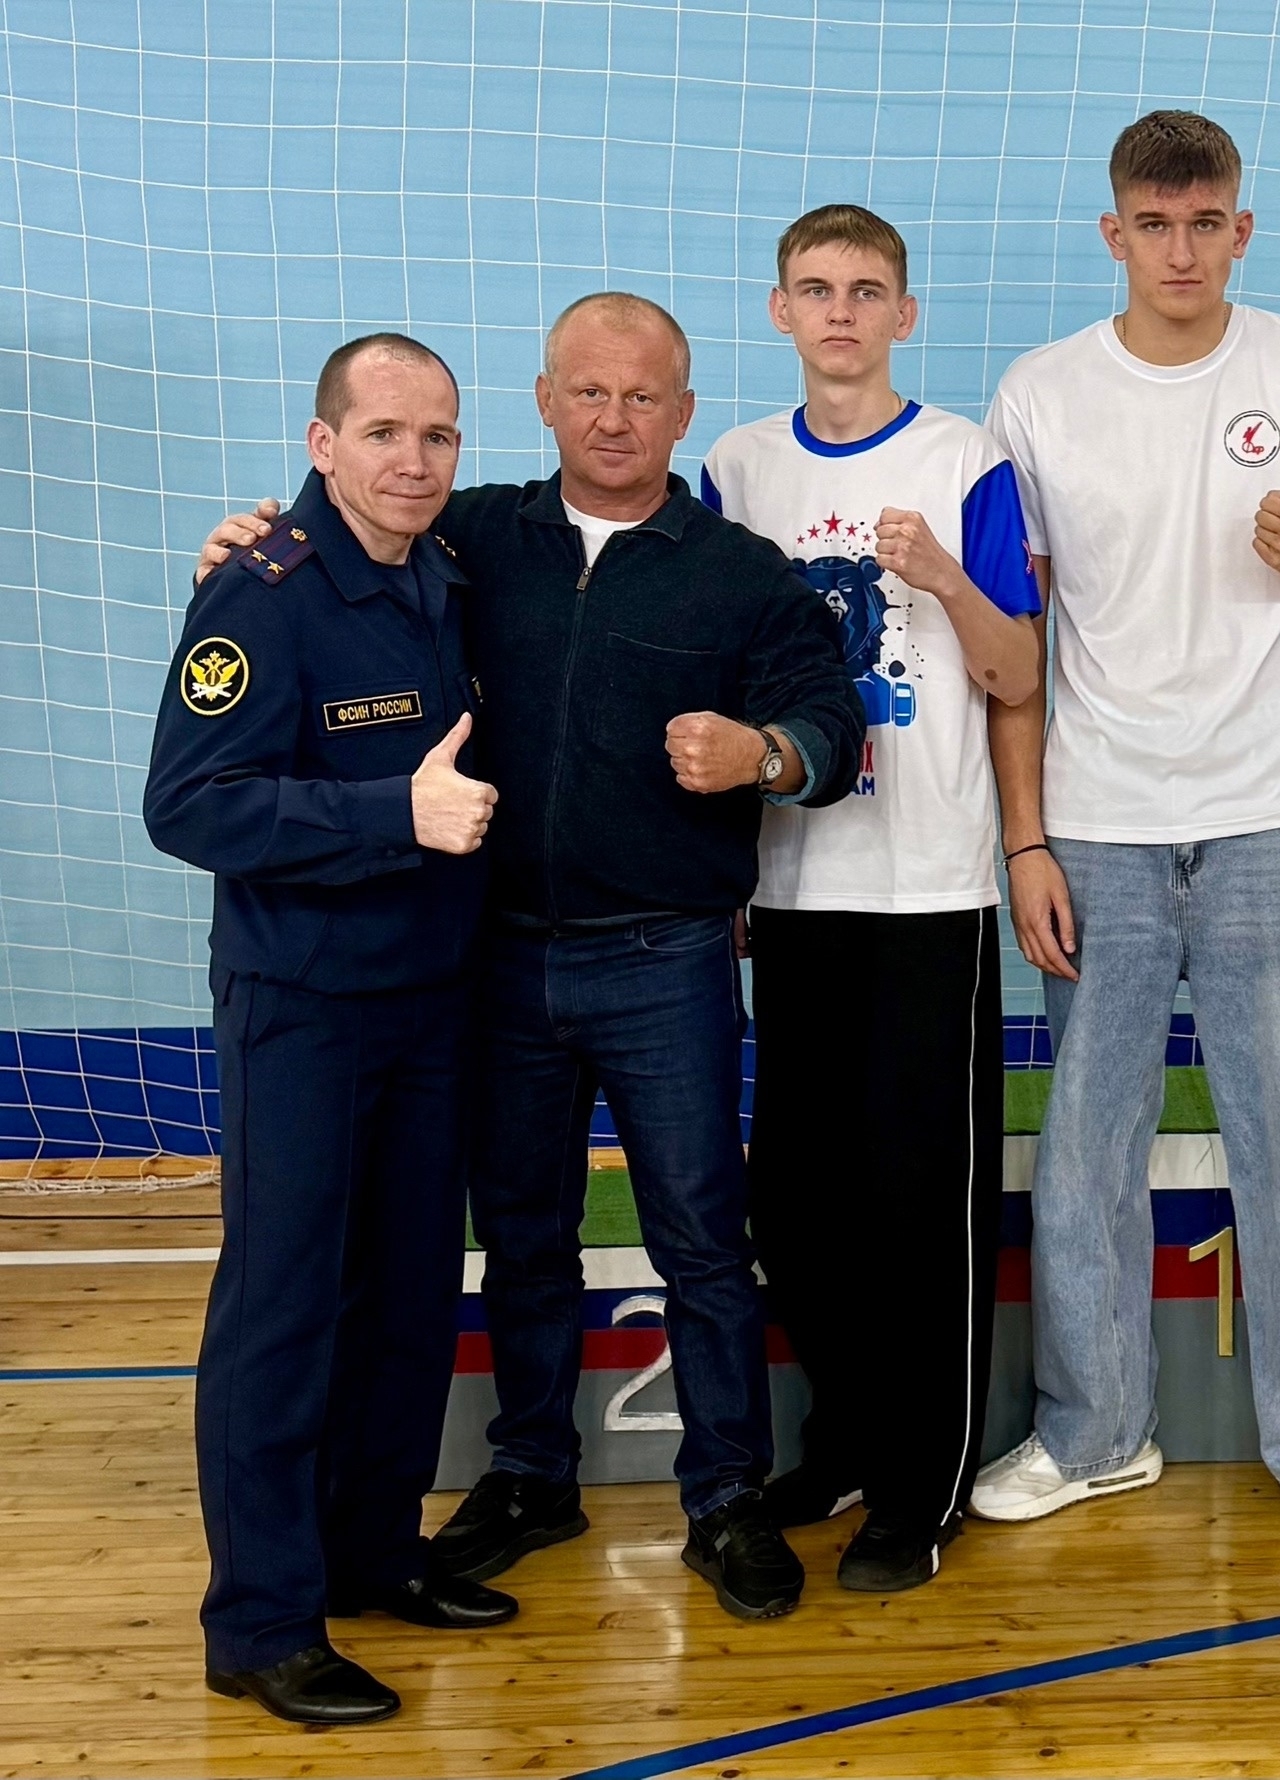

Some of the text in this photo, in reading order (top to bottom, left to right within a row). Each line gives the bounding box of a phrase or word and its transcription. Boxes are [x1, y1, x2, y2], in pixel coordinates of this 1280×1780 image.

[337, 698, 413, 722] ФСИН РОССИИ
[1188, 1226, 1234, 1356] 1
[602, 1294, 685, 1432] 2
